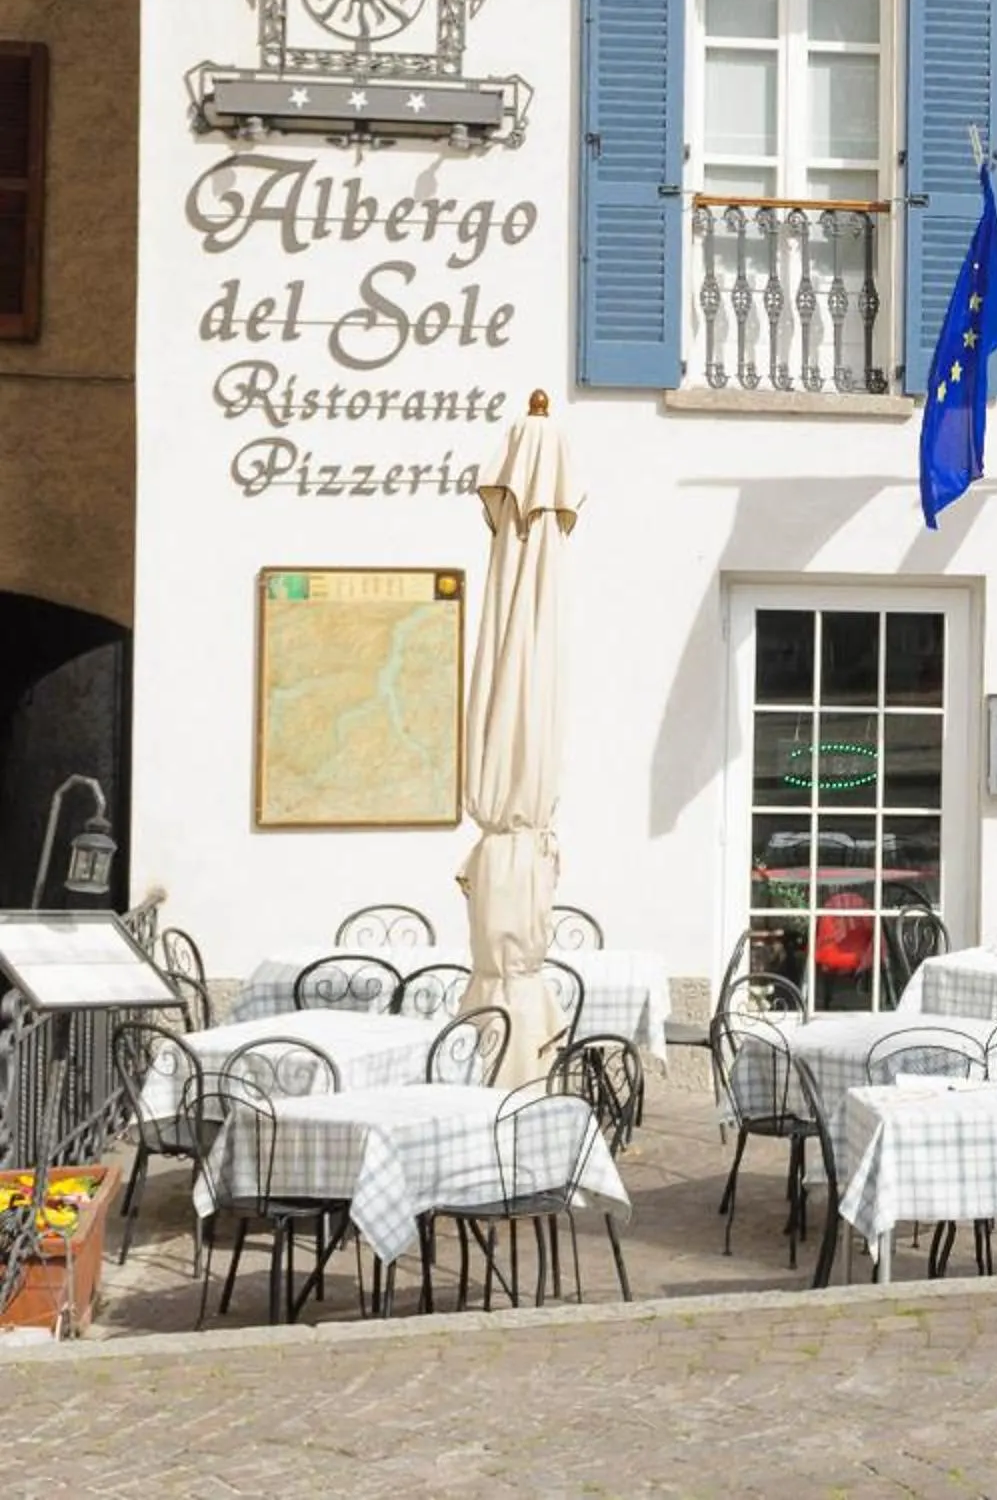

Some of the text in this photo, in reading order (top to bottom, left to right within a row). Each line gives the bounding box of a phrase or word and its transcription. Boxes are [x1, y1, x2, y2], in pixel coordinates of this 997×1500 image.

[185, 153, 538, 269] Albergo
[199, 259, 516, 371] del Sole
[212, 359, 507, 428] Ristorante
[230, 437, 481, 498] Pizzeria
